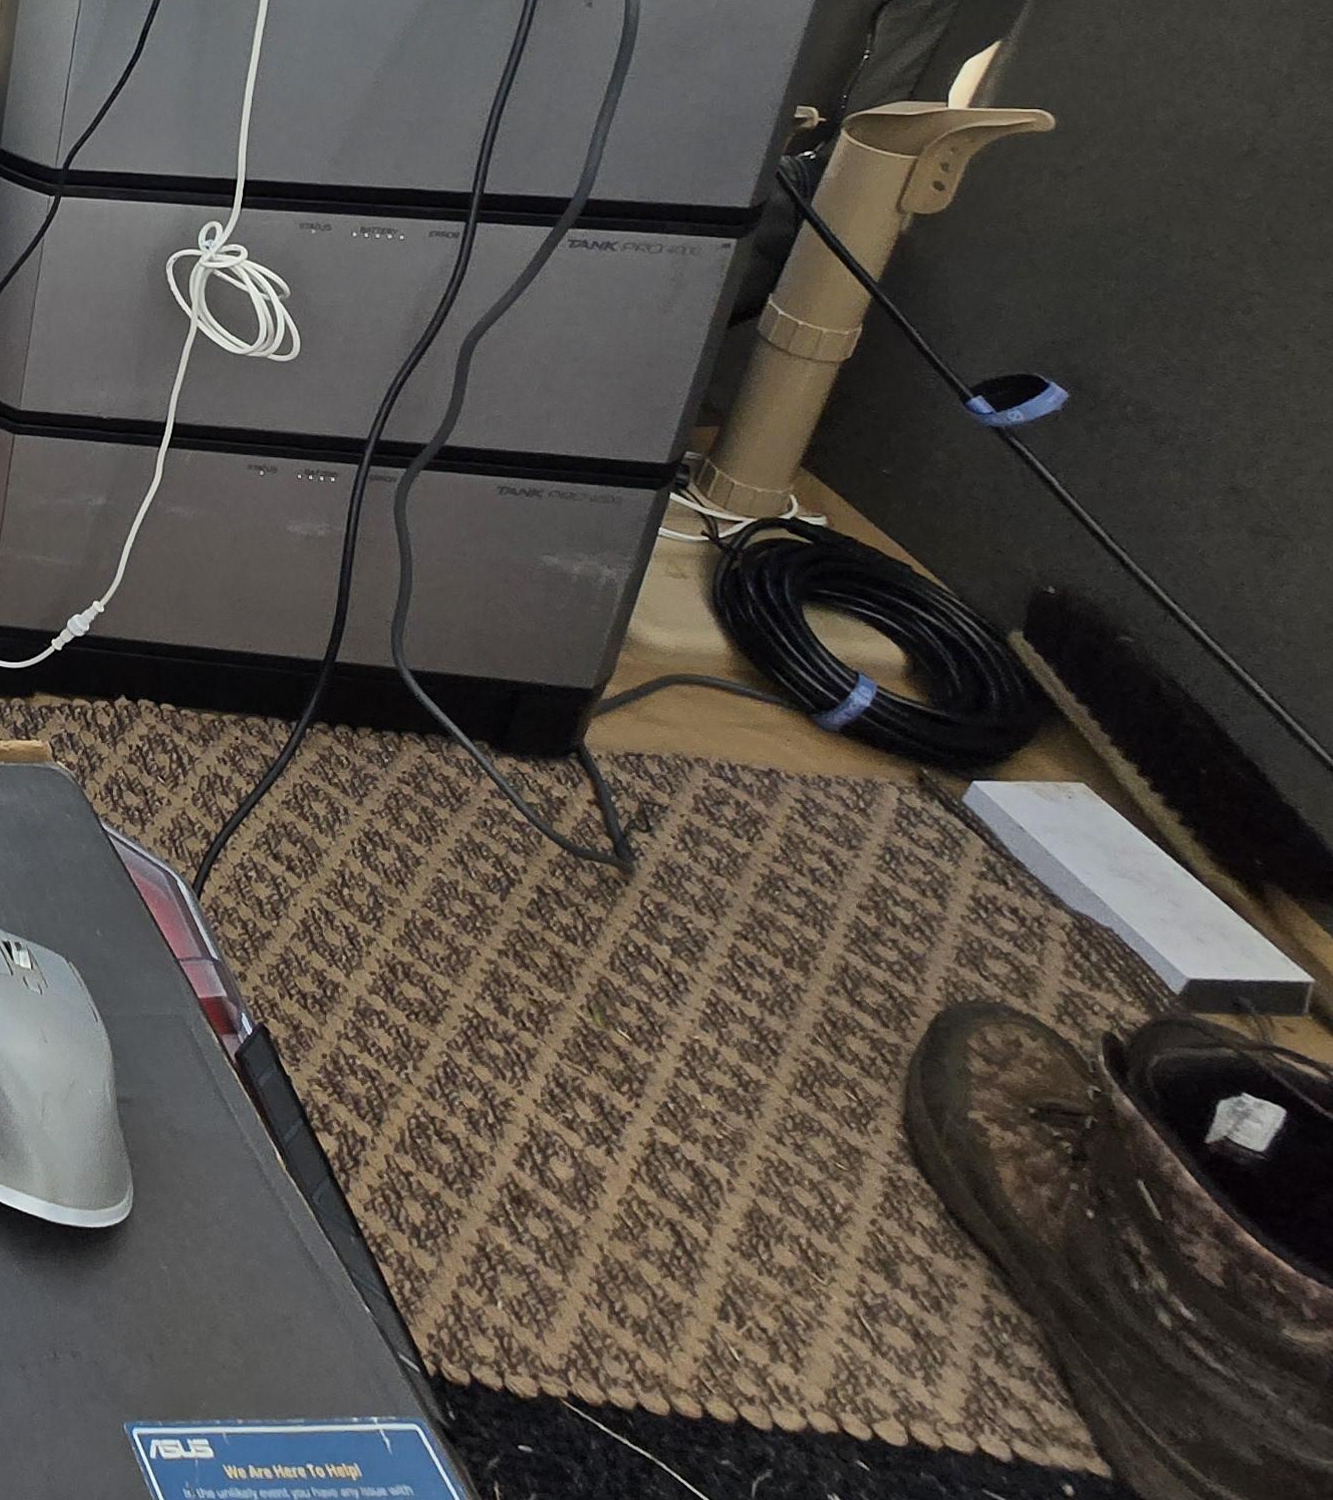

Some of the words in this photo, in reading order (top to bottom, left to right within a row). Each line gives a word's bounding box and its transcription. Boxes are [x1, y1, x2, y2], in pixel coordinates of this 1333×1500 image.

[359, 226, 399, 235] BATTERY
[567, 238, 619, 251] TANK
[150, 1438, 214, 1460] ASUS
[222, 1463, 245, 1480] We
[249, 1464, 273, 1480] Are
[274, 1463, 306, 1480] Here
[308, 1463, 325, 1478] To
[327, 1462, 363, 1482] Help!
[291, 1488, 312, 1500] you
[314, 1486, 339, 1498] have
[340, 1486, 360, 1499] any
[387, 1484, 414, 1497] with
